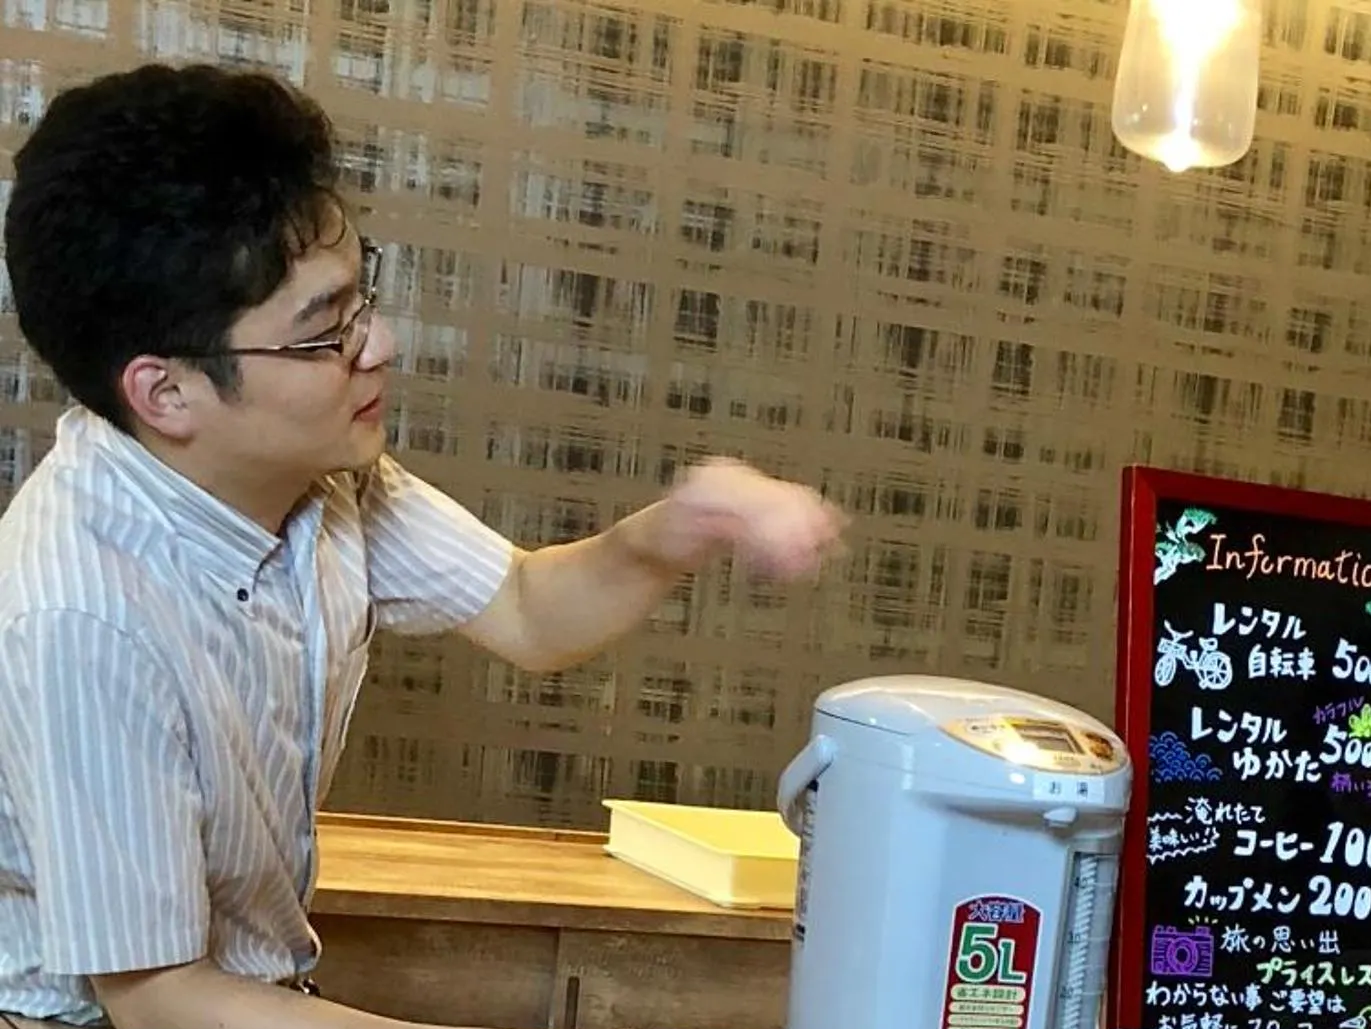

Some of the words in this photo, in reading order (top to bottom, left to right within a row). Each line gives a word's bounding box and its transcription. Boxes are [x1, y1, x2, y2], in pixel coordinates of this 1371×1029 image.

[1212, 602, 1307, 641] レンタル
[1248, 644, 1317, 681] 自転車
[1190, 706, 1288, 744] レンタル
[1312, 696, 1365, 725] カラフル
[1233, 747, 1322, 783] ゆかた
[1233, 829, 1314, 860] コーヒー
[1183, 875, 1301, 913] カップメン
[955, 921, 1027, 984] 5L
[1220, 924, 1341, 955] 旅の思い出
[1146, 980, 1263, 1012] わからない事
[1269, 988, 1347, 1015] ご要望は
